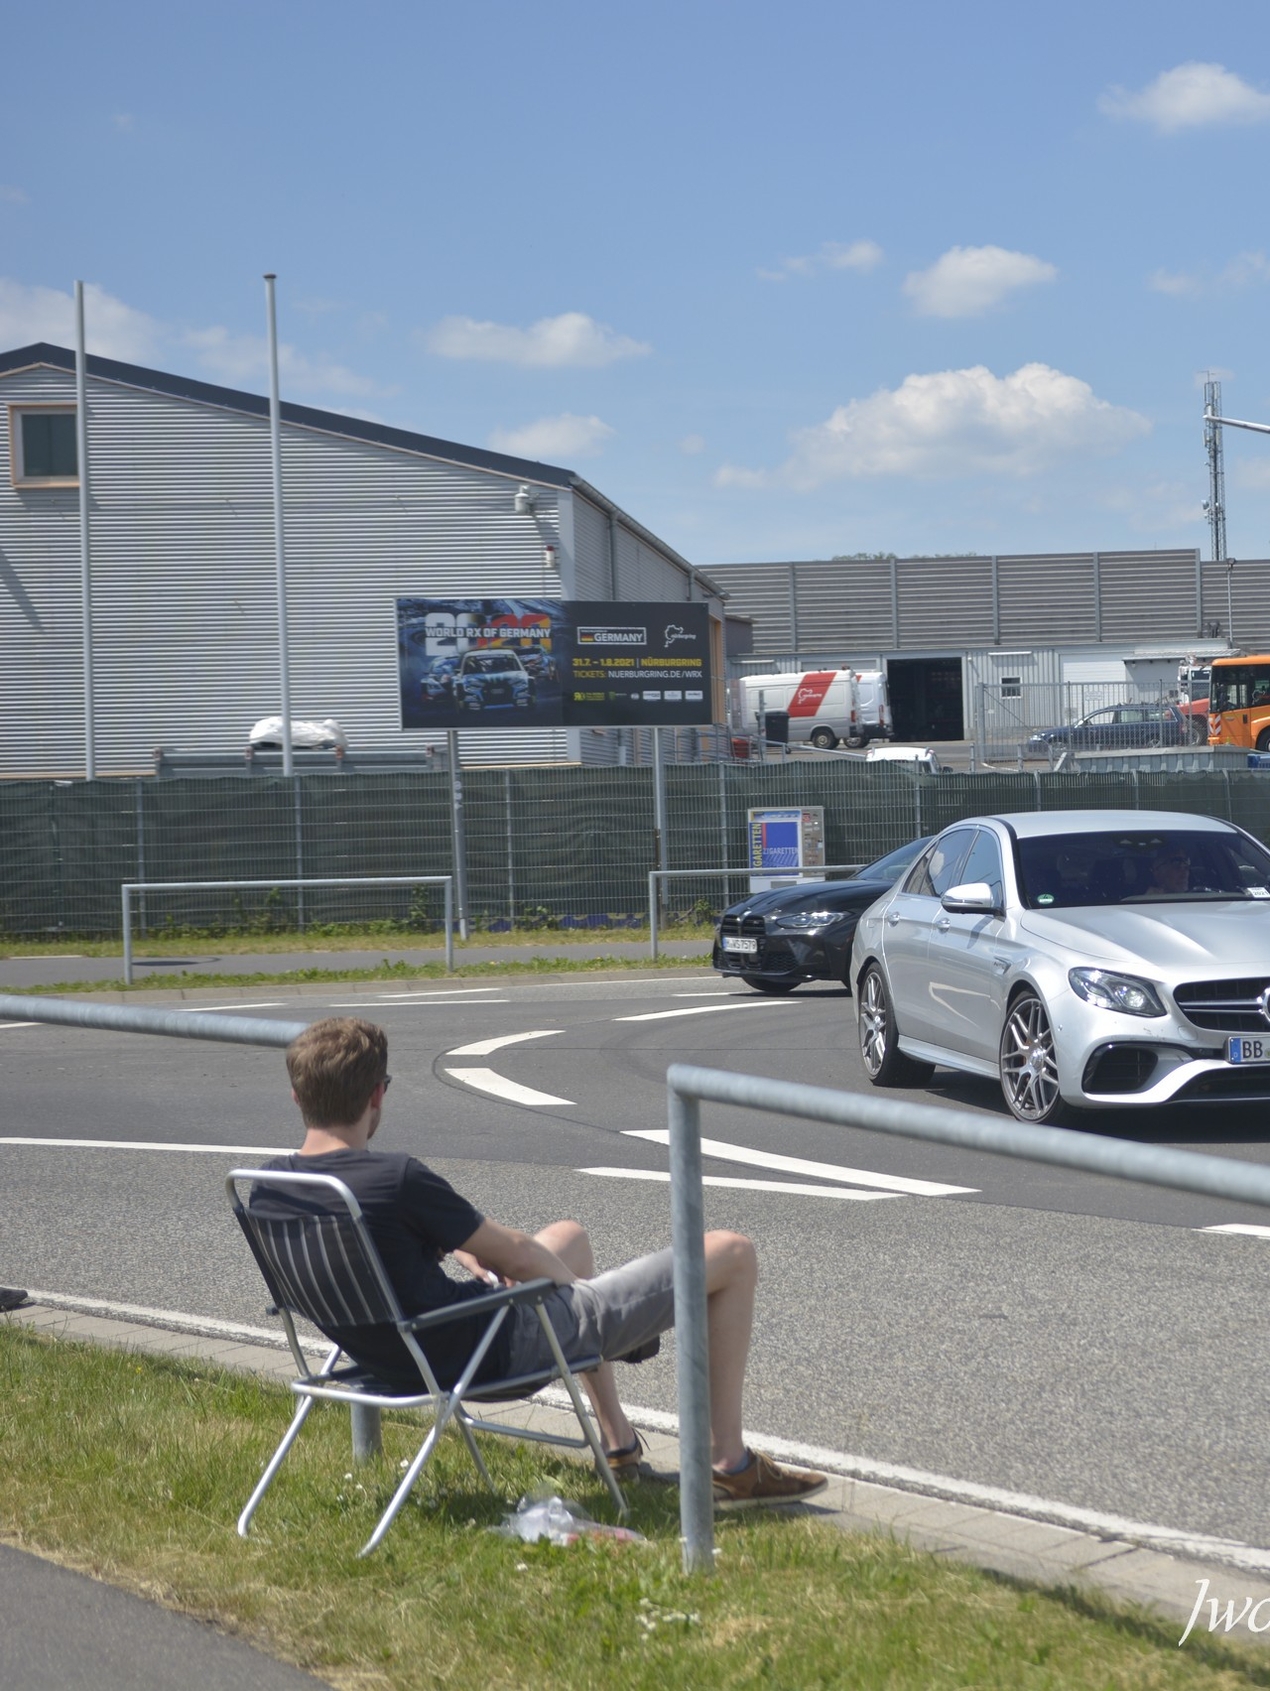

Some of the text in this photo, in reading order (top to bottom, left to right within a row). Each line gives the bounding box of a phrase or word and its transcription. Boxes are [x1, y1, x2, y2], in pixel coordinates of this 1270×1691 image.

[425, 627, 551, 638] WORLD RX OF GERMANY
[594, 632, 643, 642] GERMANY
[572, 658, 591, 667] 31.7.
[600, 658, 635, 667] 1.8.2021
[641, 656, 702, 667] NÜRBURGRING
[573, 670, 606, 678] TICKETS:
[1242, 1040, 1263, 1059] BB
